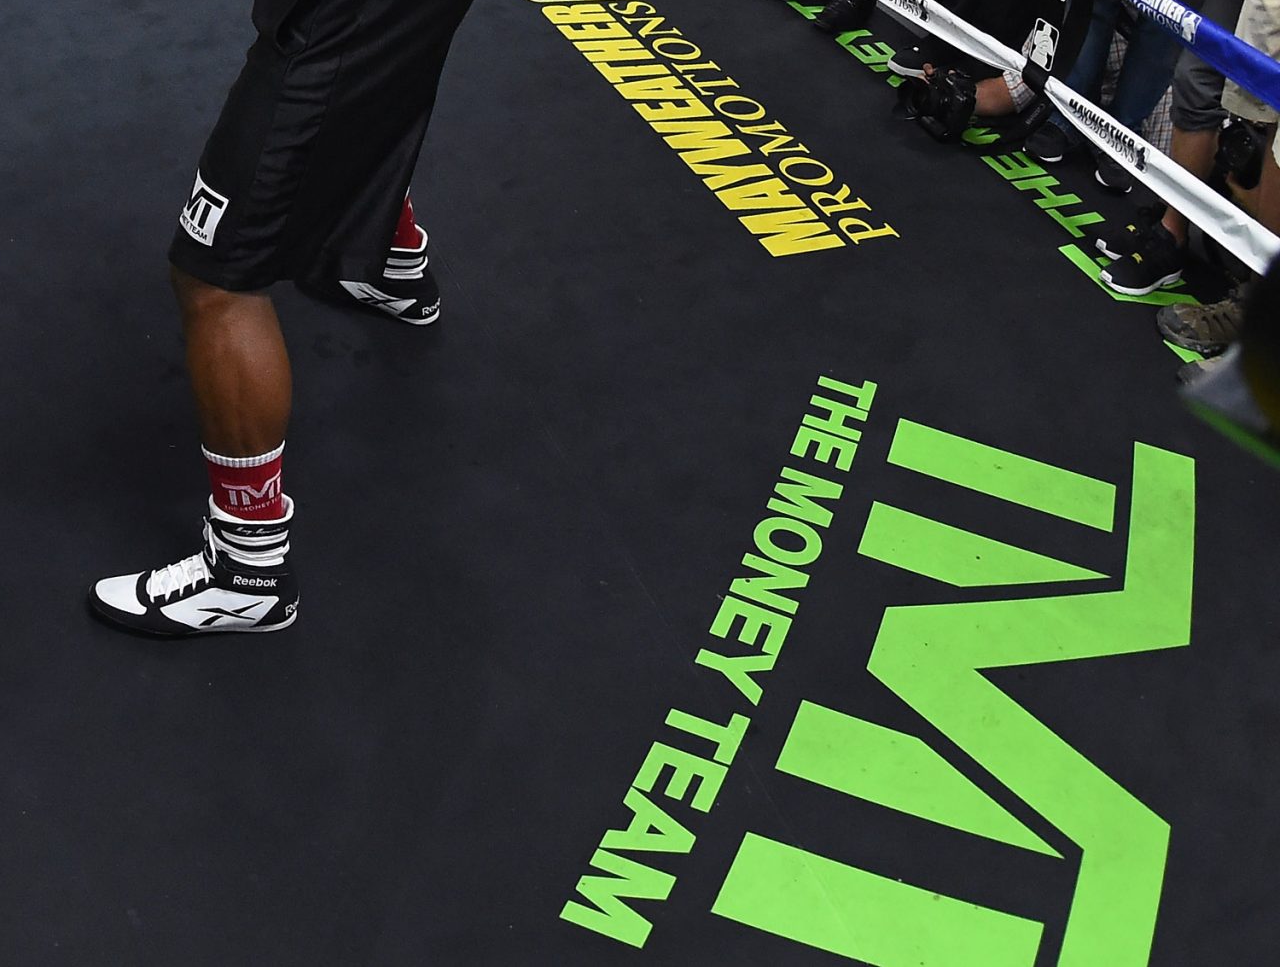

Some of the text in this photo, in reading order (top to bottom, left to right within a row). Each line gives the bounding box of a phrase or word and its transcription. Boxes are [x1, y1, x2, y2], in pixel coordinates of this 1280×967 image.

[542, 3, 847, 257] MAYWEATHER
[609, 1, 901, 245] PROMOTIONS
[1070, 98, 1136, 149] MAYWEATHER
[189, 222, 208, 241] TEAM
[981, 151, 1105, 238] THE
[239, 501, 270, 512] MONEY
[232, 575, 278, 587] Reebok
[558, 376, 878, 949] THE MONEY TEAM
[711, 417, 1196, 967] TMT
